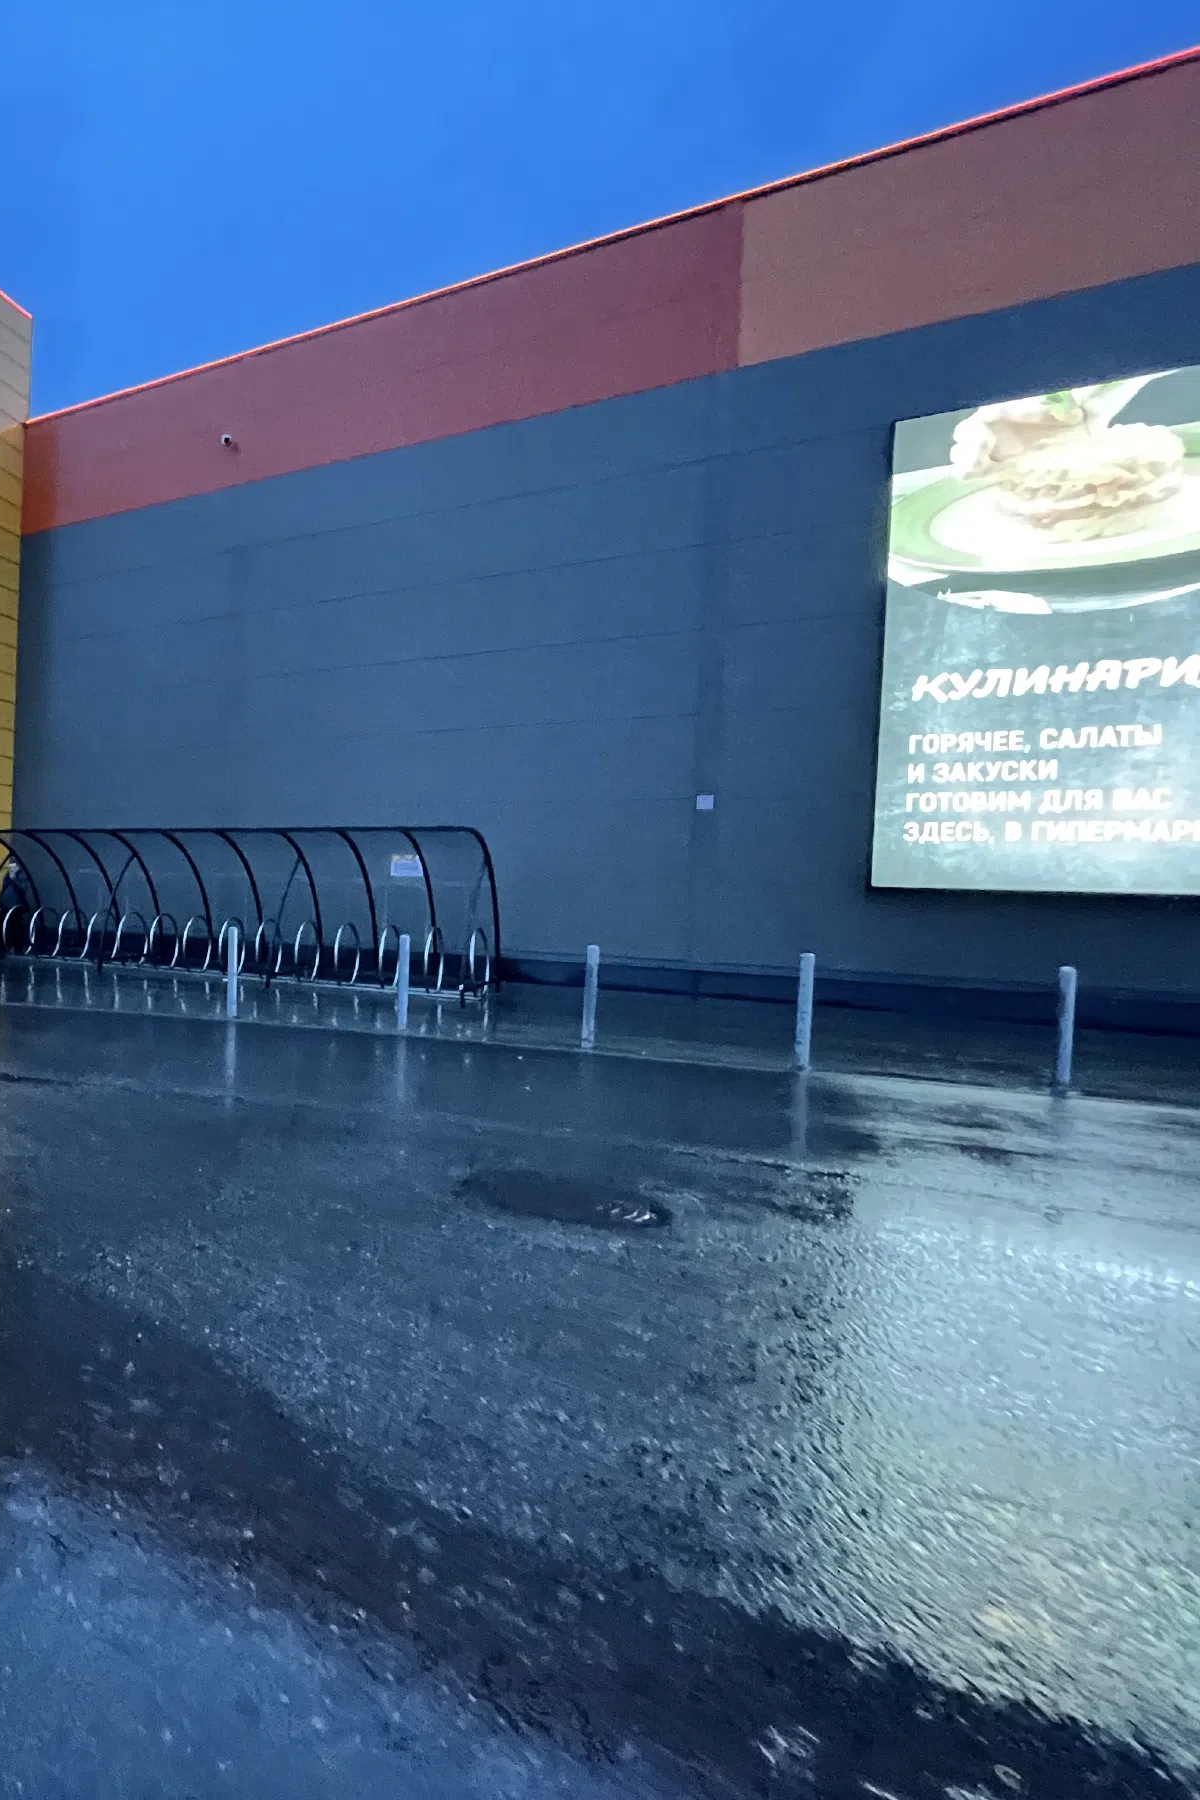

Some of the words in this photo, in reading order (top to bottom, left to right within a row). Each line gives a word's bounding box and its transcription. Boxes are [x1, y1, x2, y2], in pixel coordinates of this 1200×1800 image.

[911, 653, 1200, 703] КУЛИНАРИ
[908, 729, 1031, 754] ГОРЯЧЕЕ,
[1039, 723, 1163, 750] САЛАТЫ
[907, 763, 925, 783] И
[932, 759, 1059, 783] ЗАКУСКИ
[905, 790, 1031, 813] ГОТОВИМ
[1037, 788, 1103, 815] ДЛЯ
[1111, 787, 1173, 812] ВАС
[902, 821, 995, 845] ЗДЕСЬ,
[1004, 821, 1022, 842] В
